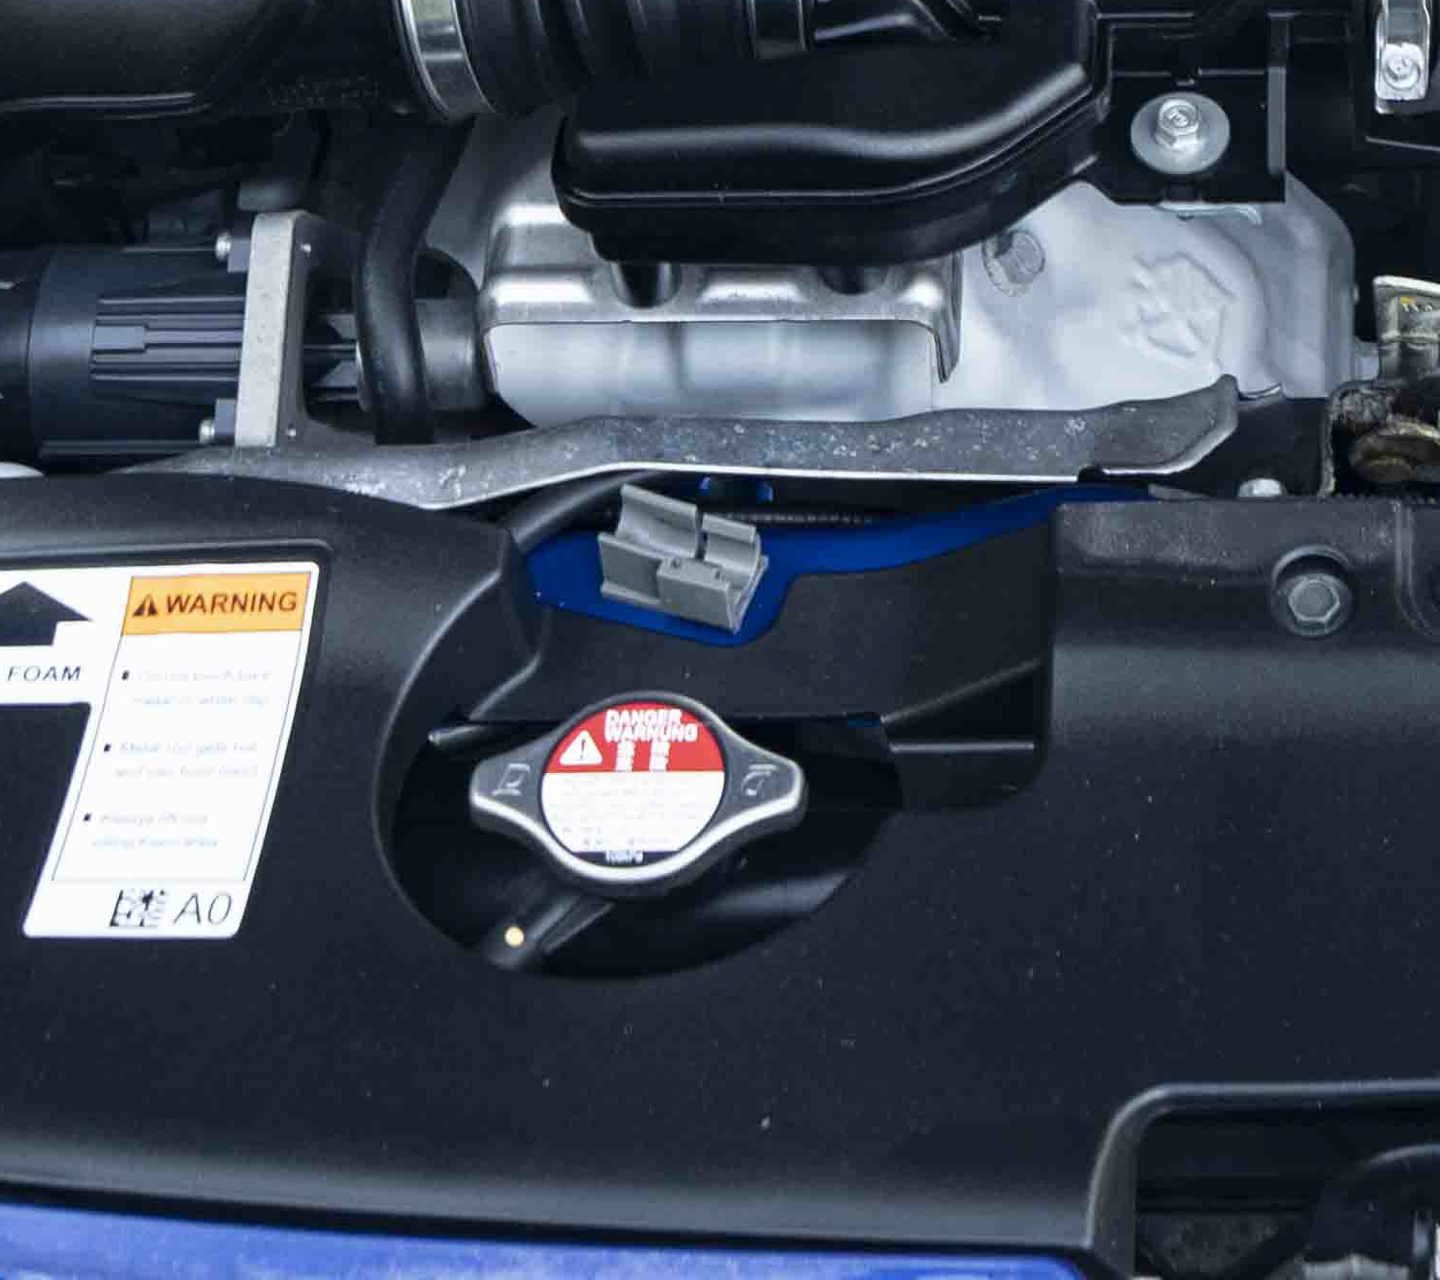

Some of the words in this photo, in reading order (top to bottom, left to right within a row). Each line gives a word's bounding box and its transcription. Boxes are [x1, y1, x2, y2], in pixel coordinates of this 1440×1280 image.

[165, 591, 298, 616] WARNING
[7, 665, 82, 682] FOAM
[605, 709, 682, 724] DANGER
[172, 892, 233, 925] A0
